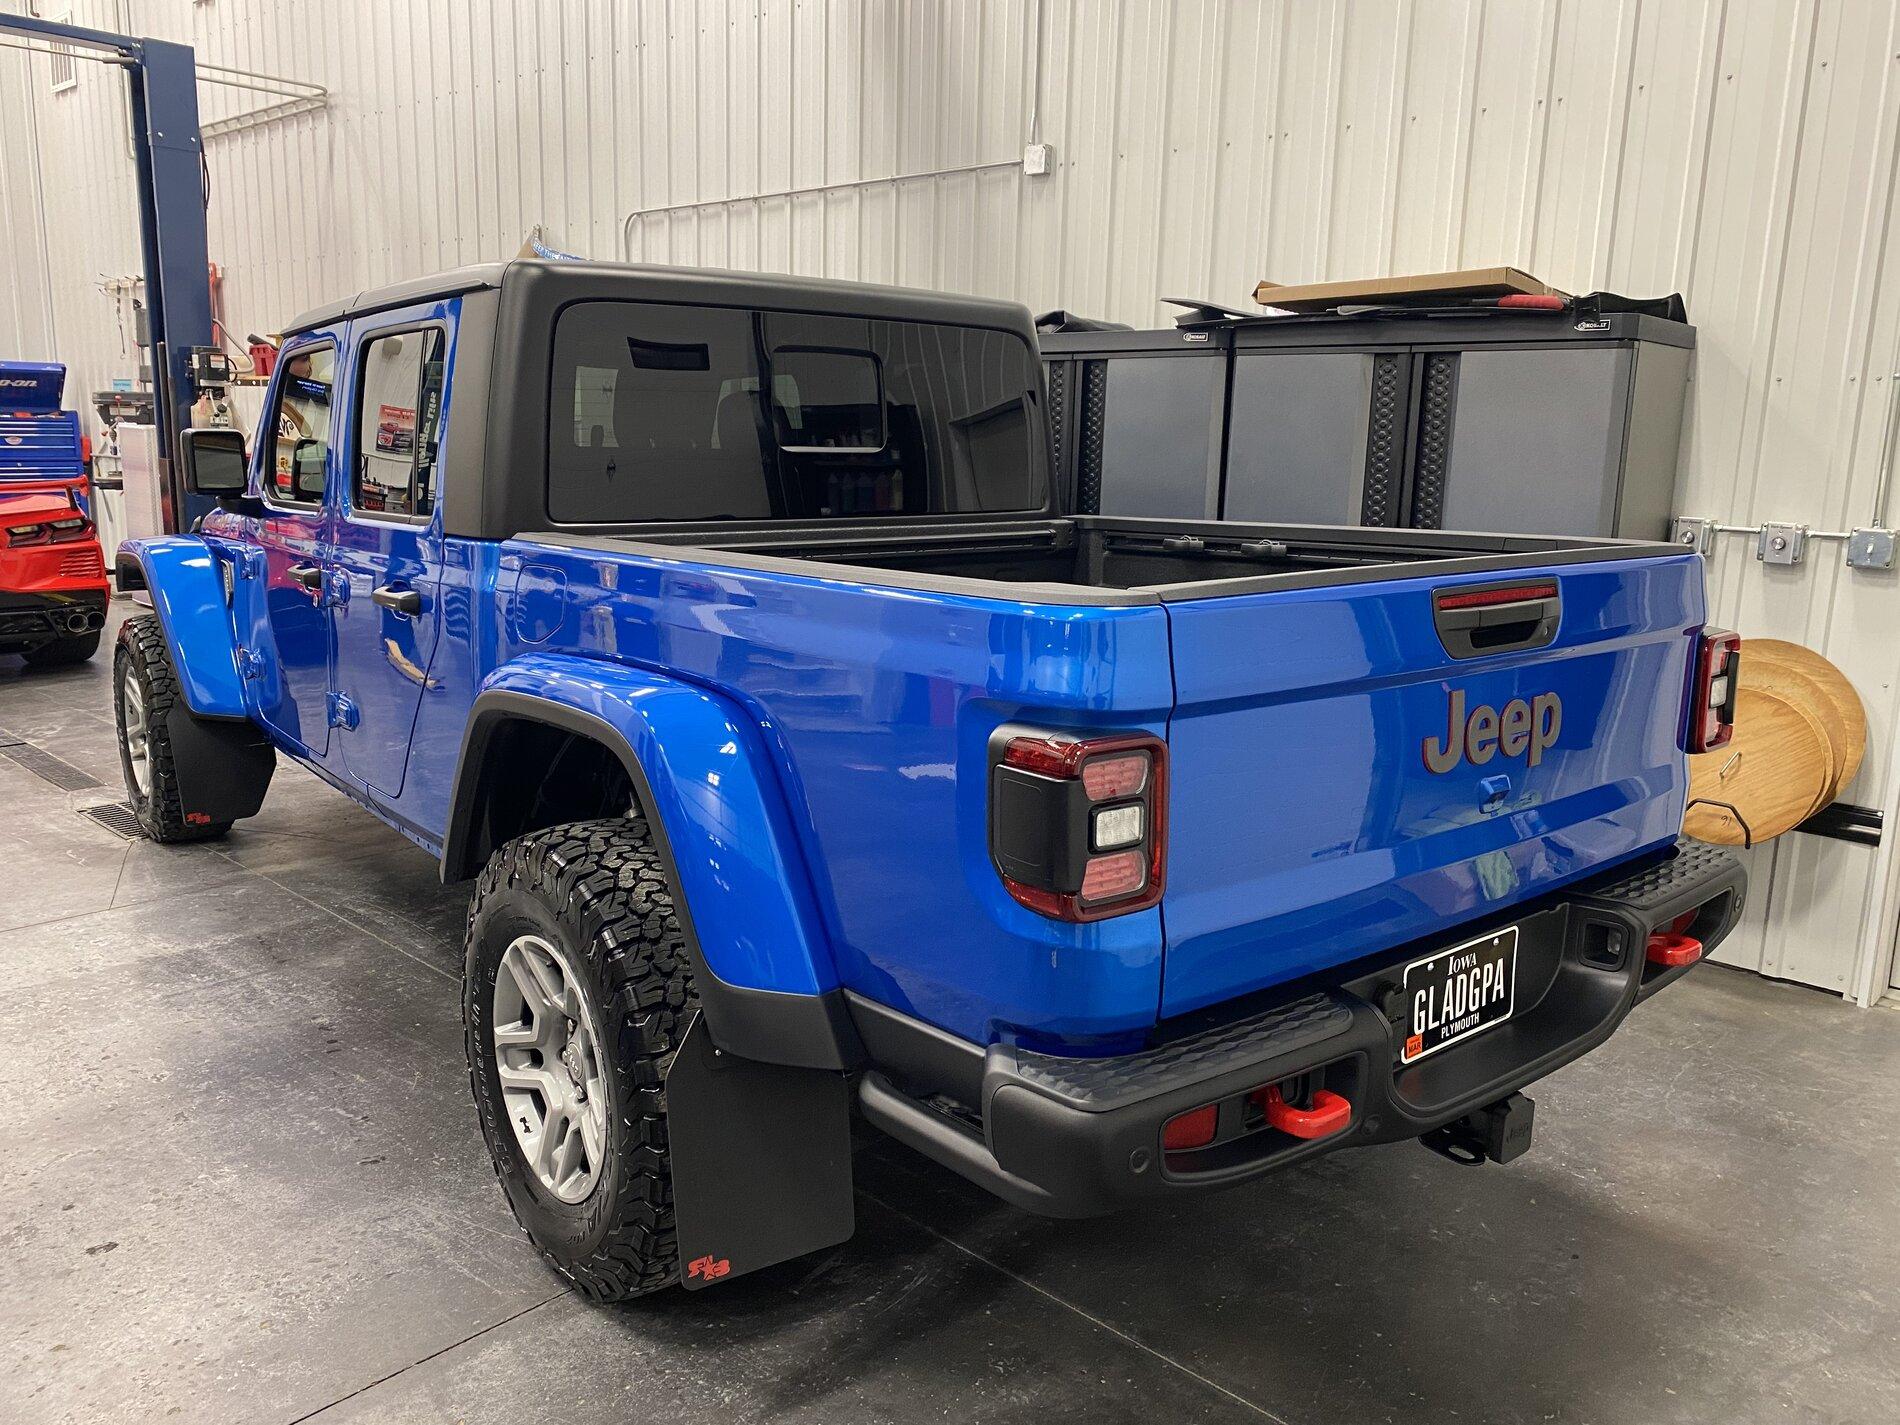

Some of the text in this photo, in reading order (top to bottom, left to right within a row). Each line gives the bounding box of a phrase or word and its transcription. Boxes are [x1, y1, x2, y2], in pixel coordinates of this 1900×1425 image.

[1422, 688, 1563, 774] Jeep
[1413, 957, 1505, 1036] GLADGPA
[1408, 1041, 1422, 1054] MAR
[1441, 1012, 1480, 1039] PLYMOUTH
